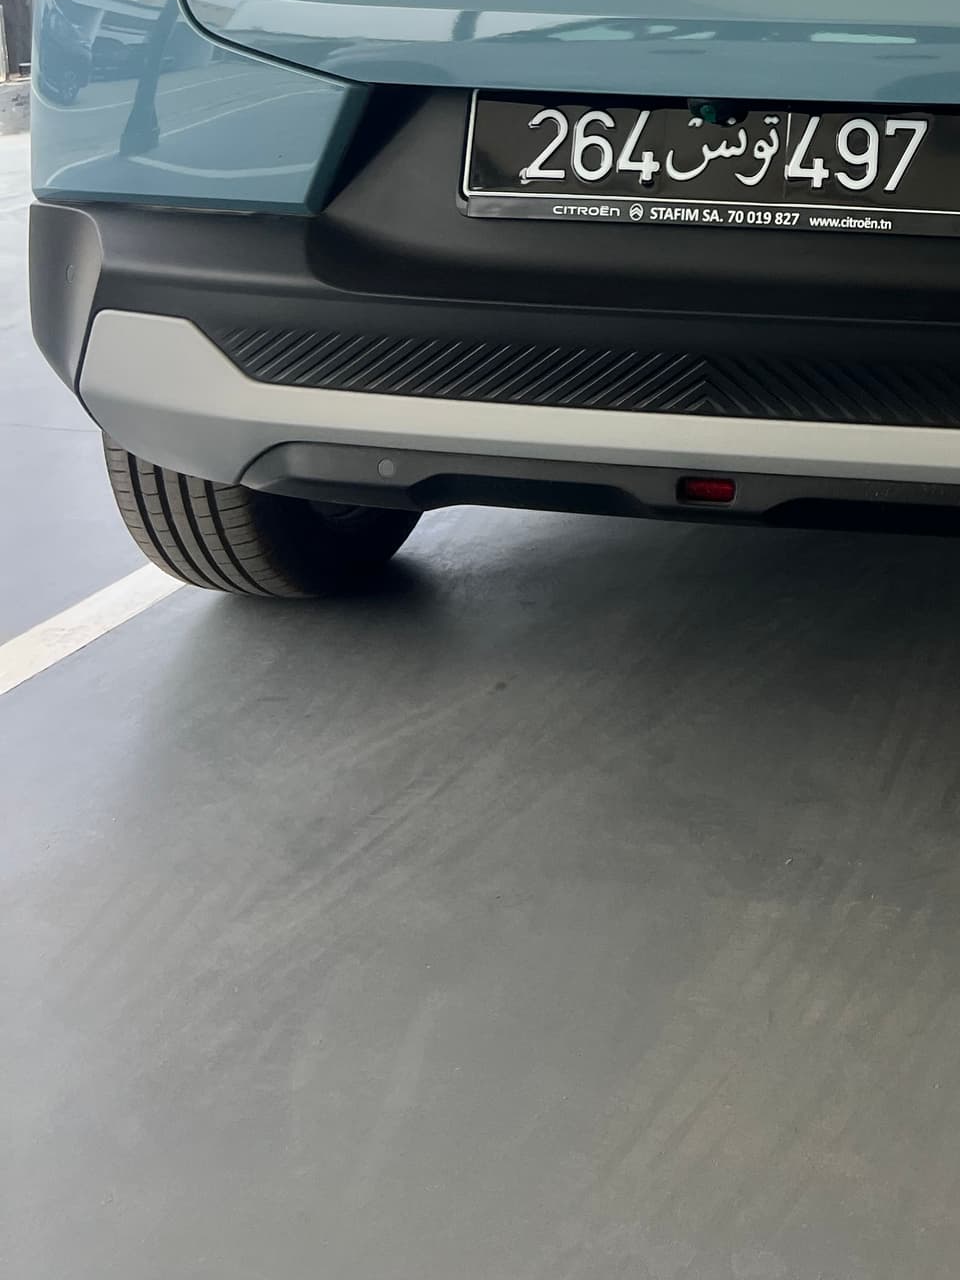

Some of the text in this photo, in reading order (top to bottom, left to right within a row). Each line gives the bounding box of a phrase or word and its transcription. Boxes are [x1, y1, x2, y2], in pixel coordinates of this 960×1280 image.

[520, 108, 928, 191] 264 تونس 497
[650, 207, 699, 222] STAFIM
[702, 209, 724, 223] SA.
[727, 210, 744, 223] 70
[746, 211, 772, 224] 019
[774, 212, 800, 225] 827
[809, 216, 892, 230] www.citroën.tn
